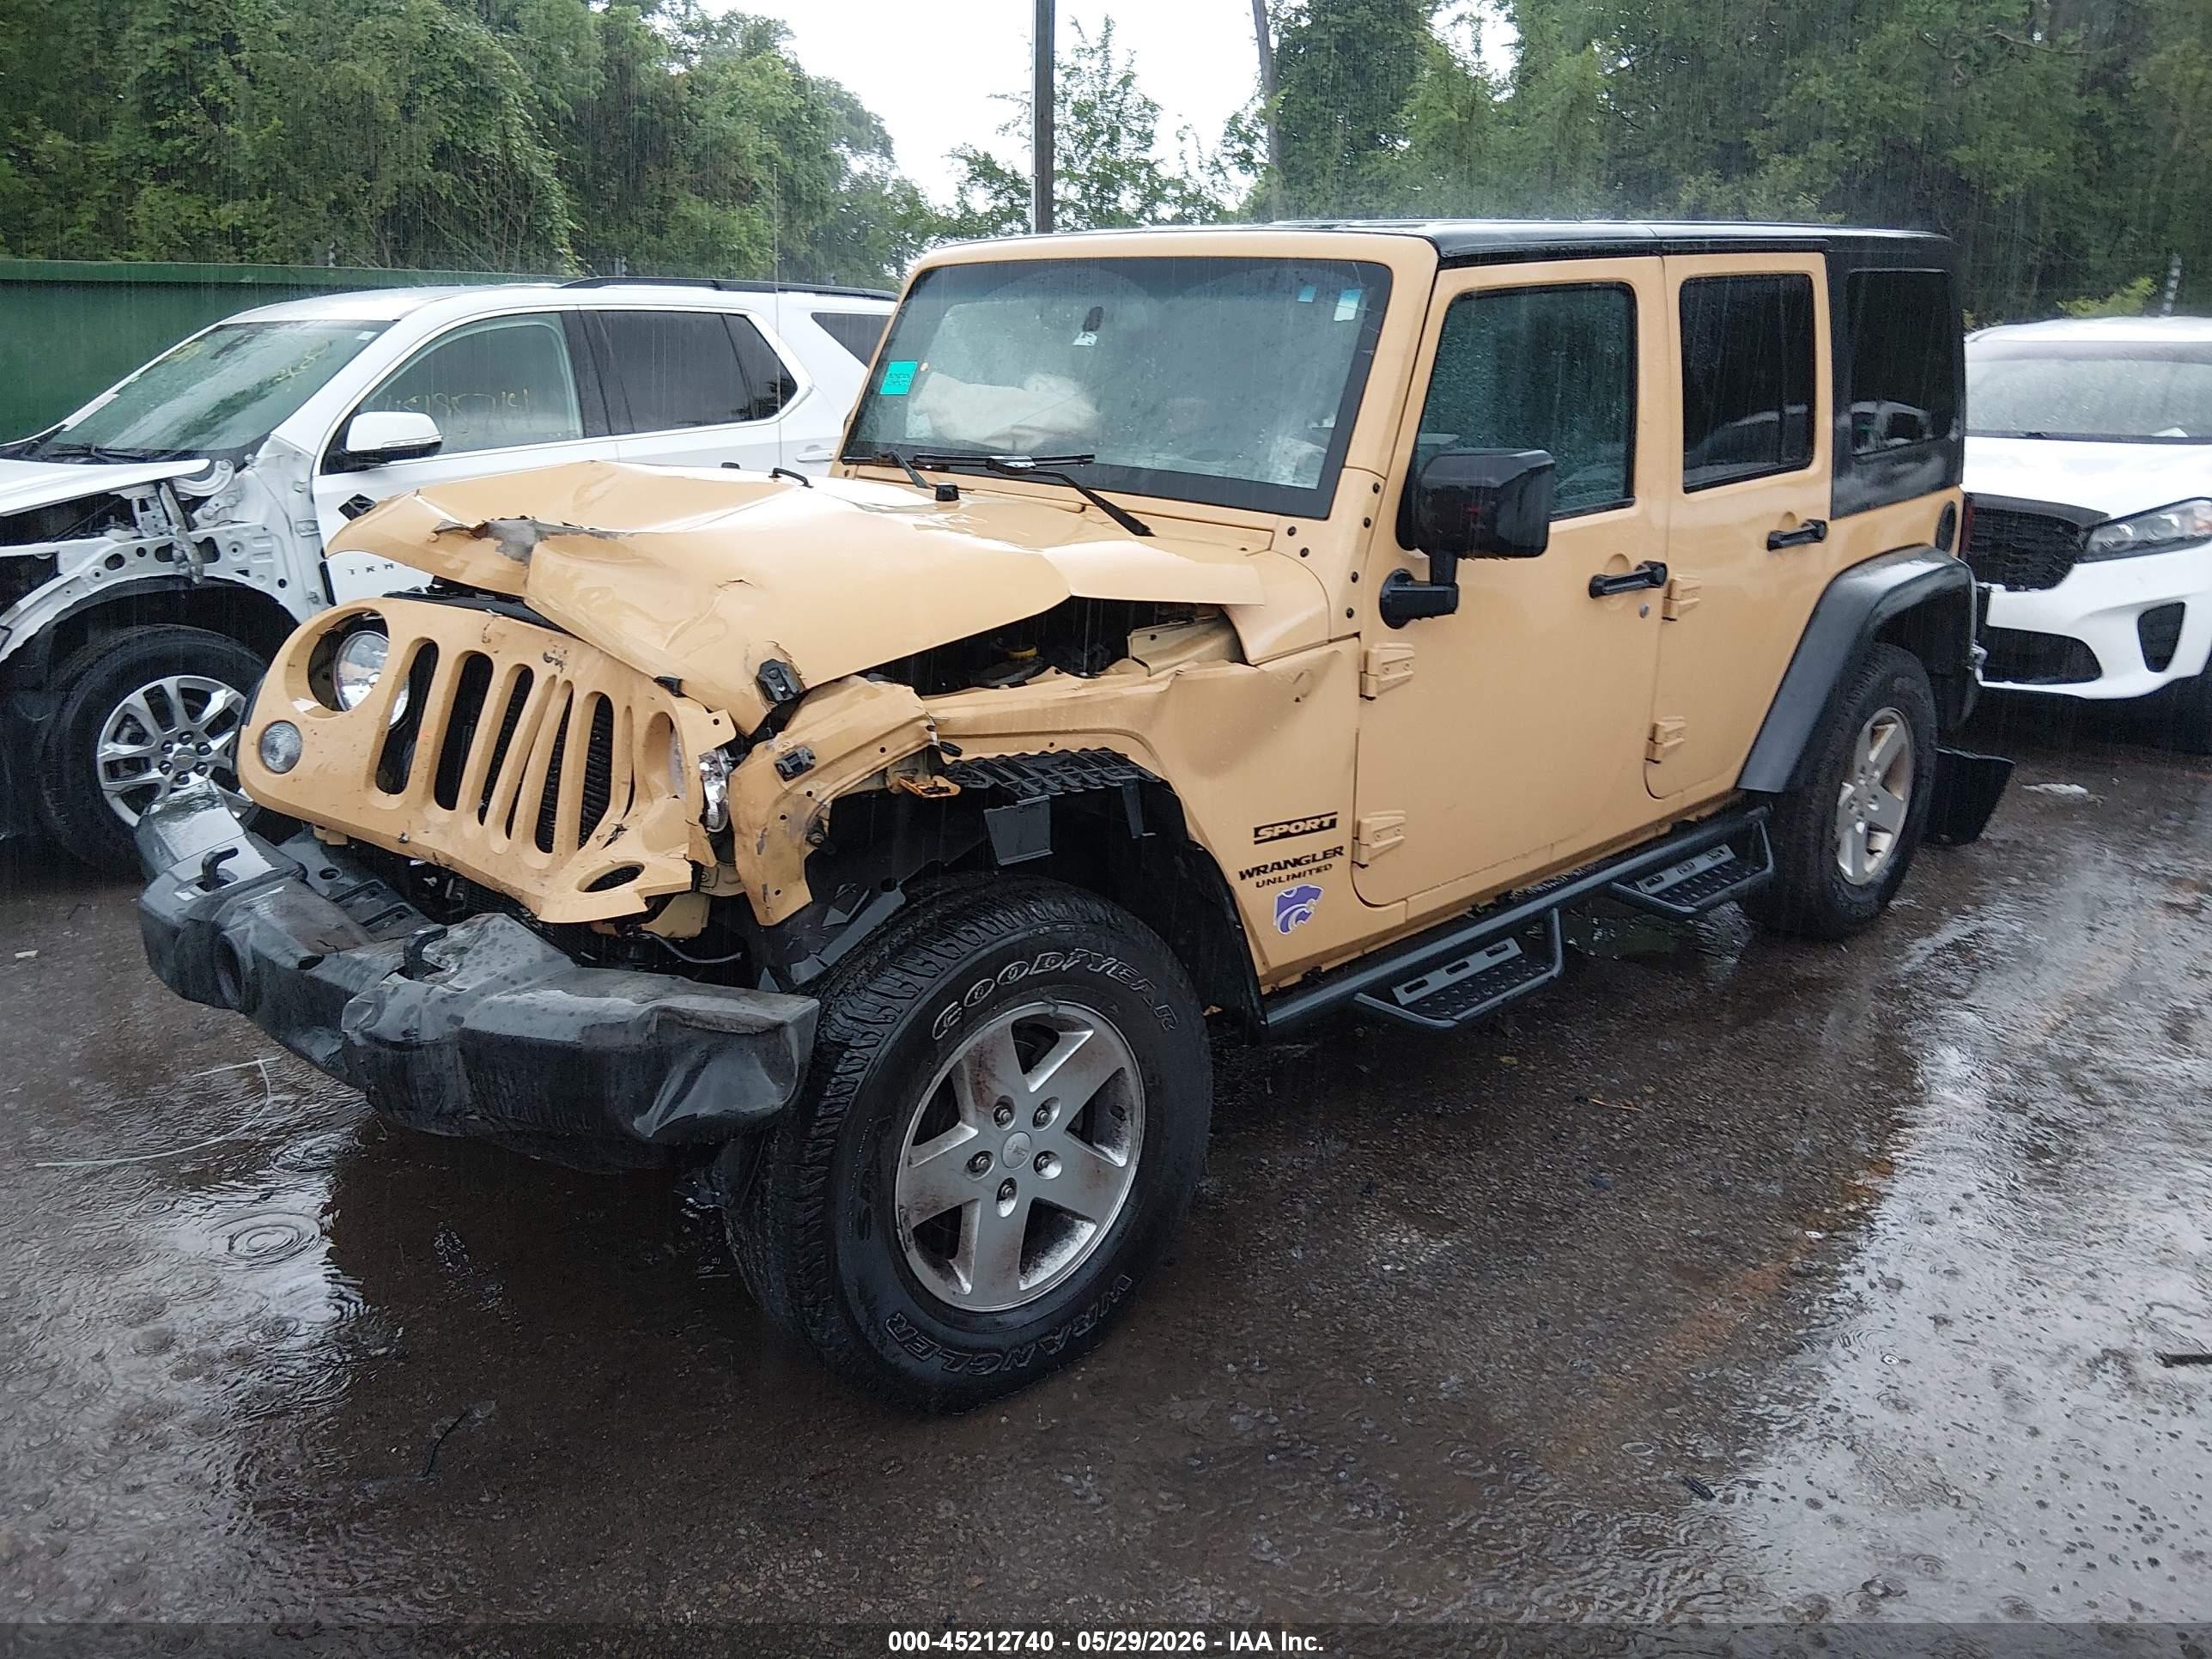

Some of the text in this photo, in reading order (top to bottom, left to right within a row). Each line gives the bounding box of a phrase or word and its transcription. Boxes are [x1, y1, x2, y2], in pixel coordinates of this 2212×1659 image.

[1256, 816, 1334, 840] SPORT
[1239, 845, 1346, 881] WRANGLER
[1255, 863, 1334, 889] UNLIMITED
[932, 947, 1179, 1041] GOODYEAR
[884, 1273, 1133, 1376] WRANGLER
